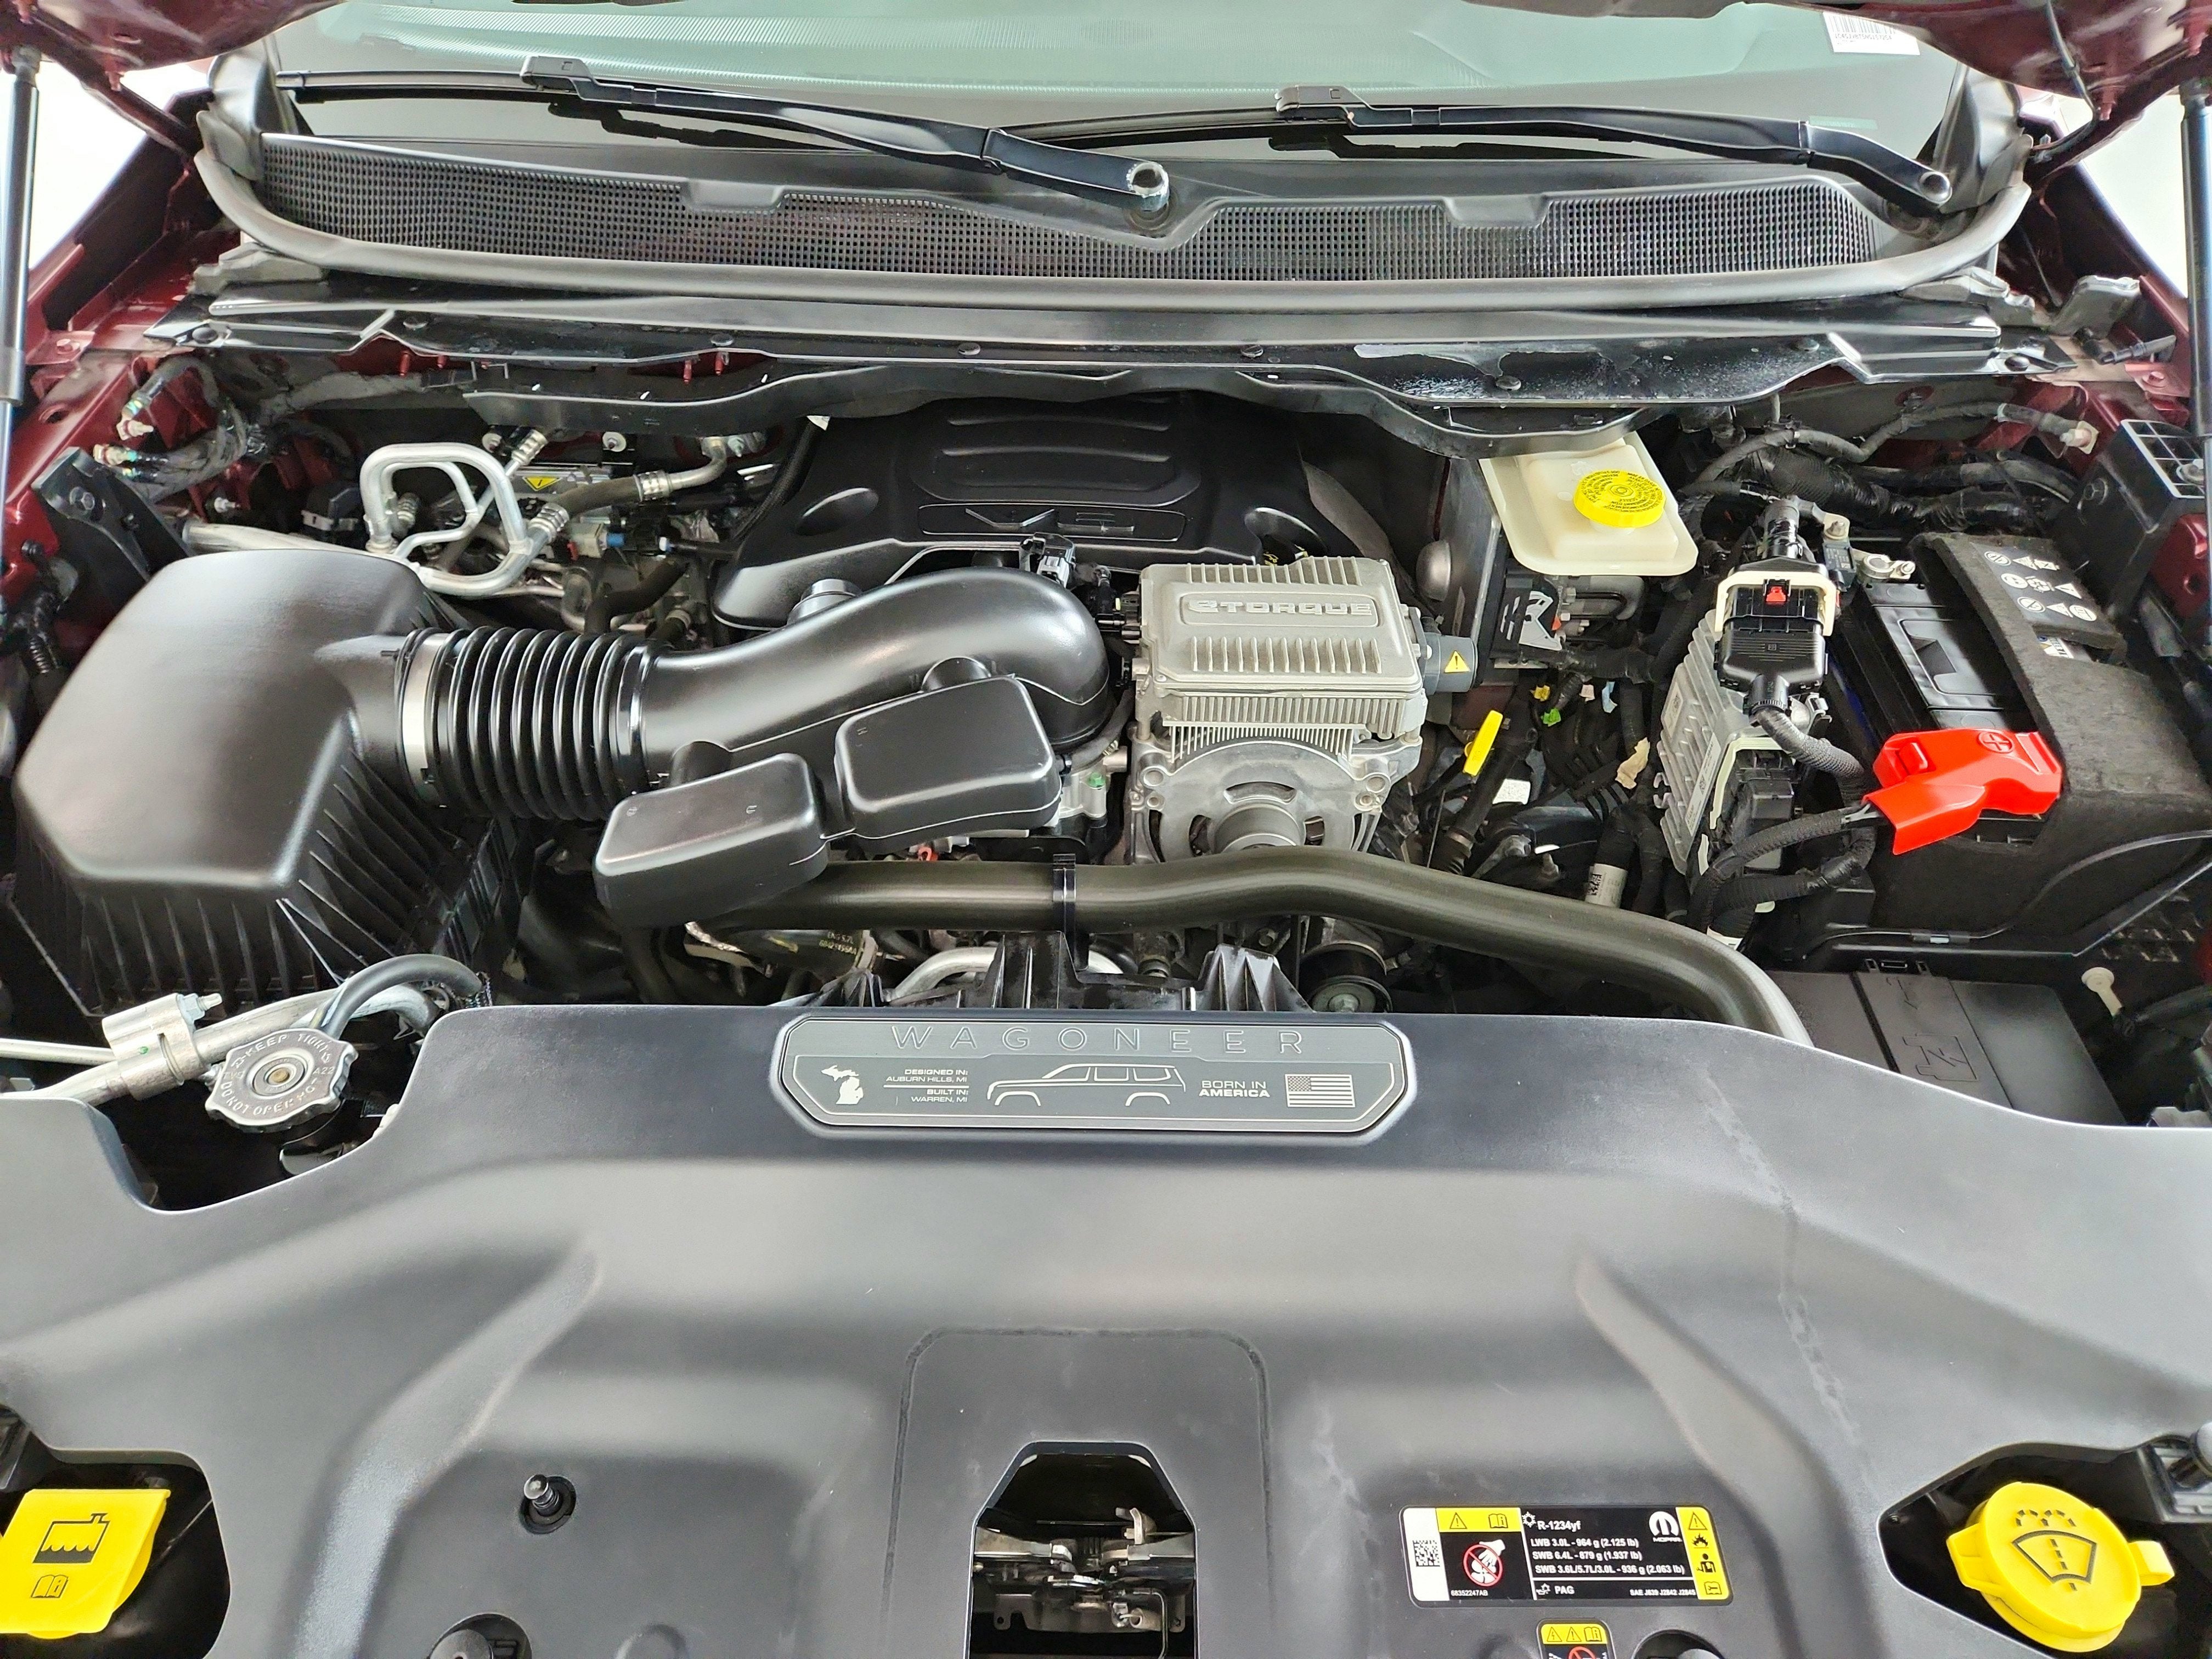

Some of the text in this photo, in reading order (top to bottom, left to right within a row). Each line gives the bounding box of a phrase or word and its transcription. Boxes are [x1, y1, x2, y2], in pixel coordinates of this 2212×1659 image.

[891, 1025, 1302, 1053] WAGONEER
[313, 1066, 334, 1075] A22
[221, 1081, 233, 1097] DO
[1201, 1080, 1245, 1089] BORN
[1199, 1089, 1271, 1097] AMERICA
[226, 1096, 250, 1115] NOT
[253, 1098, 295, 1116] OPEN
[1537, 1521, 1581, 1532] R-1234yf
[1531, 1538, 1550, 1547] LWB
[1551, 1538, 1571, 1547] 3.0L
[1576, 1538, 1592, 1547] 964
[1593, 1540, 1600, 1548] g
[1600, 1538, 1627, 1548] (2.125
[1627, 1538, 1639, 1548] lb)
[1532, 1551, 1553, 1560] SWB
[1554, 1551, 1573, 1560] 6.4L
[1579, 1551, 1595, 1560] 879
[1596, 1553, 1603, 1561] g
[1604, 1551, 1629, 1561] (1.937
[1630, 1551, 1642, 1561] lb)
[1535, 1565, 1556, 1573] SWB
[1557, 1565, 1616, 1573] 3.6L/5.7L/3.0L
[1621, 1565, 1638, 1573] 936
[1639, 1566, 1646, 1575] g
[1646, 1565, 1672, 1575] (2.063
[1673, 1565, 1685, 1575] lb)
[1554, 1585, 1575, 1594] PAG
